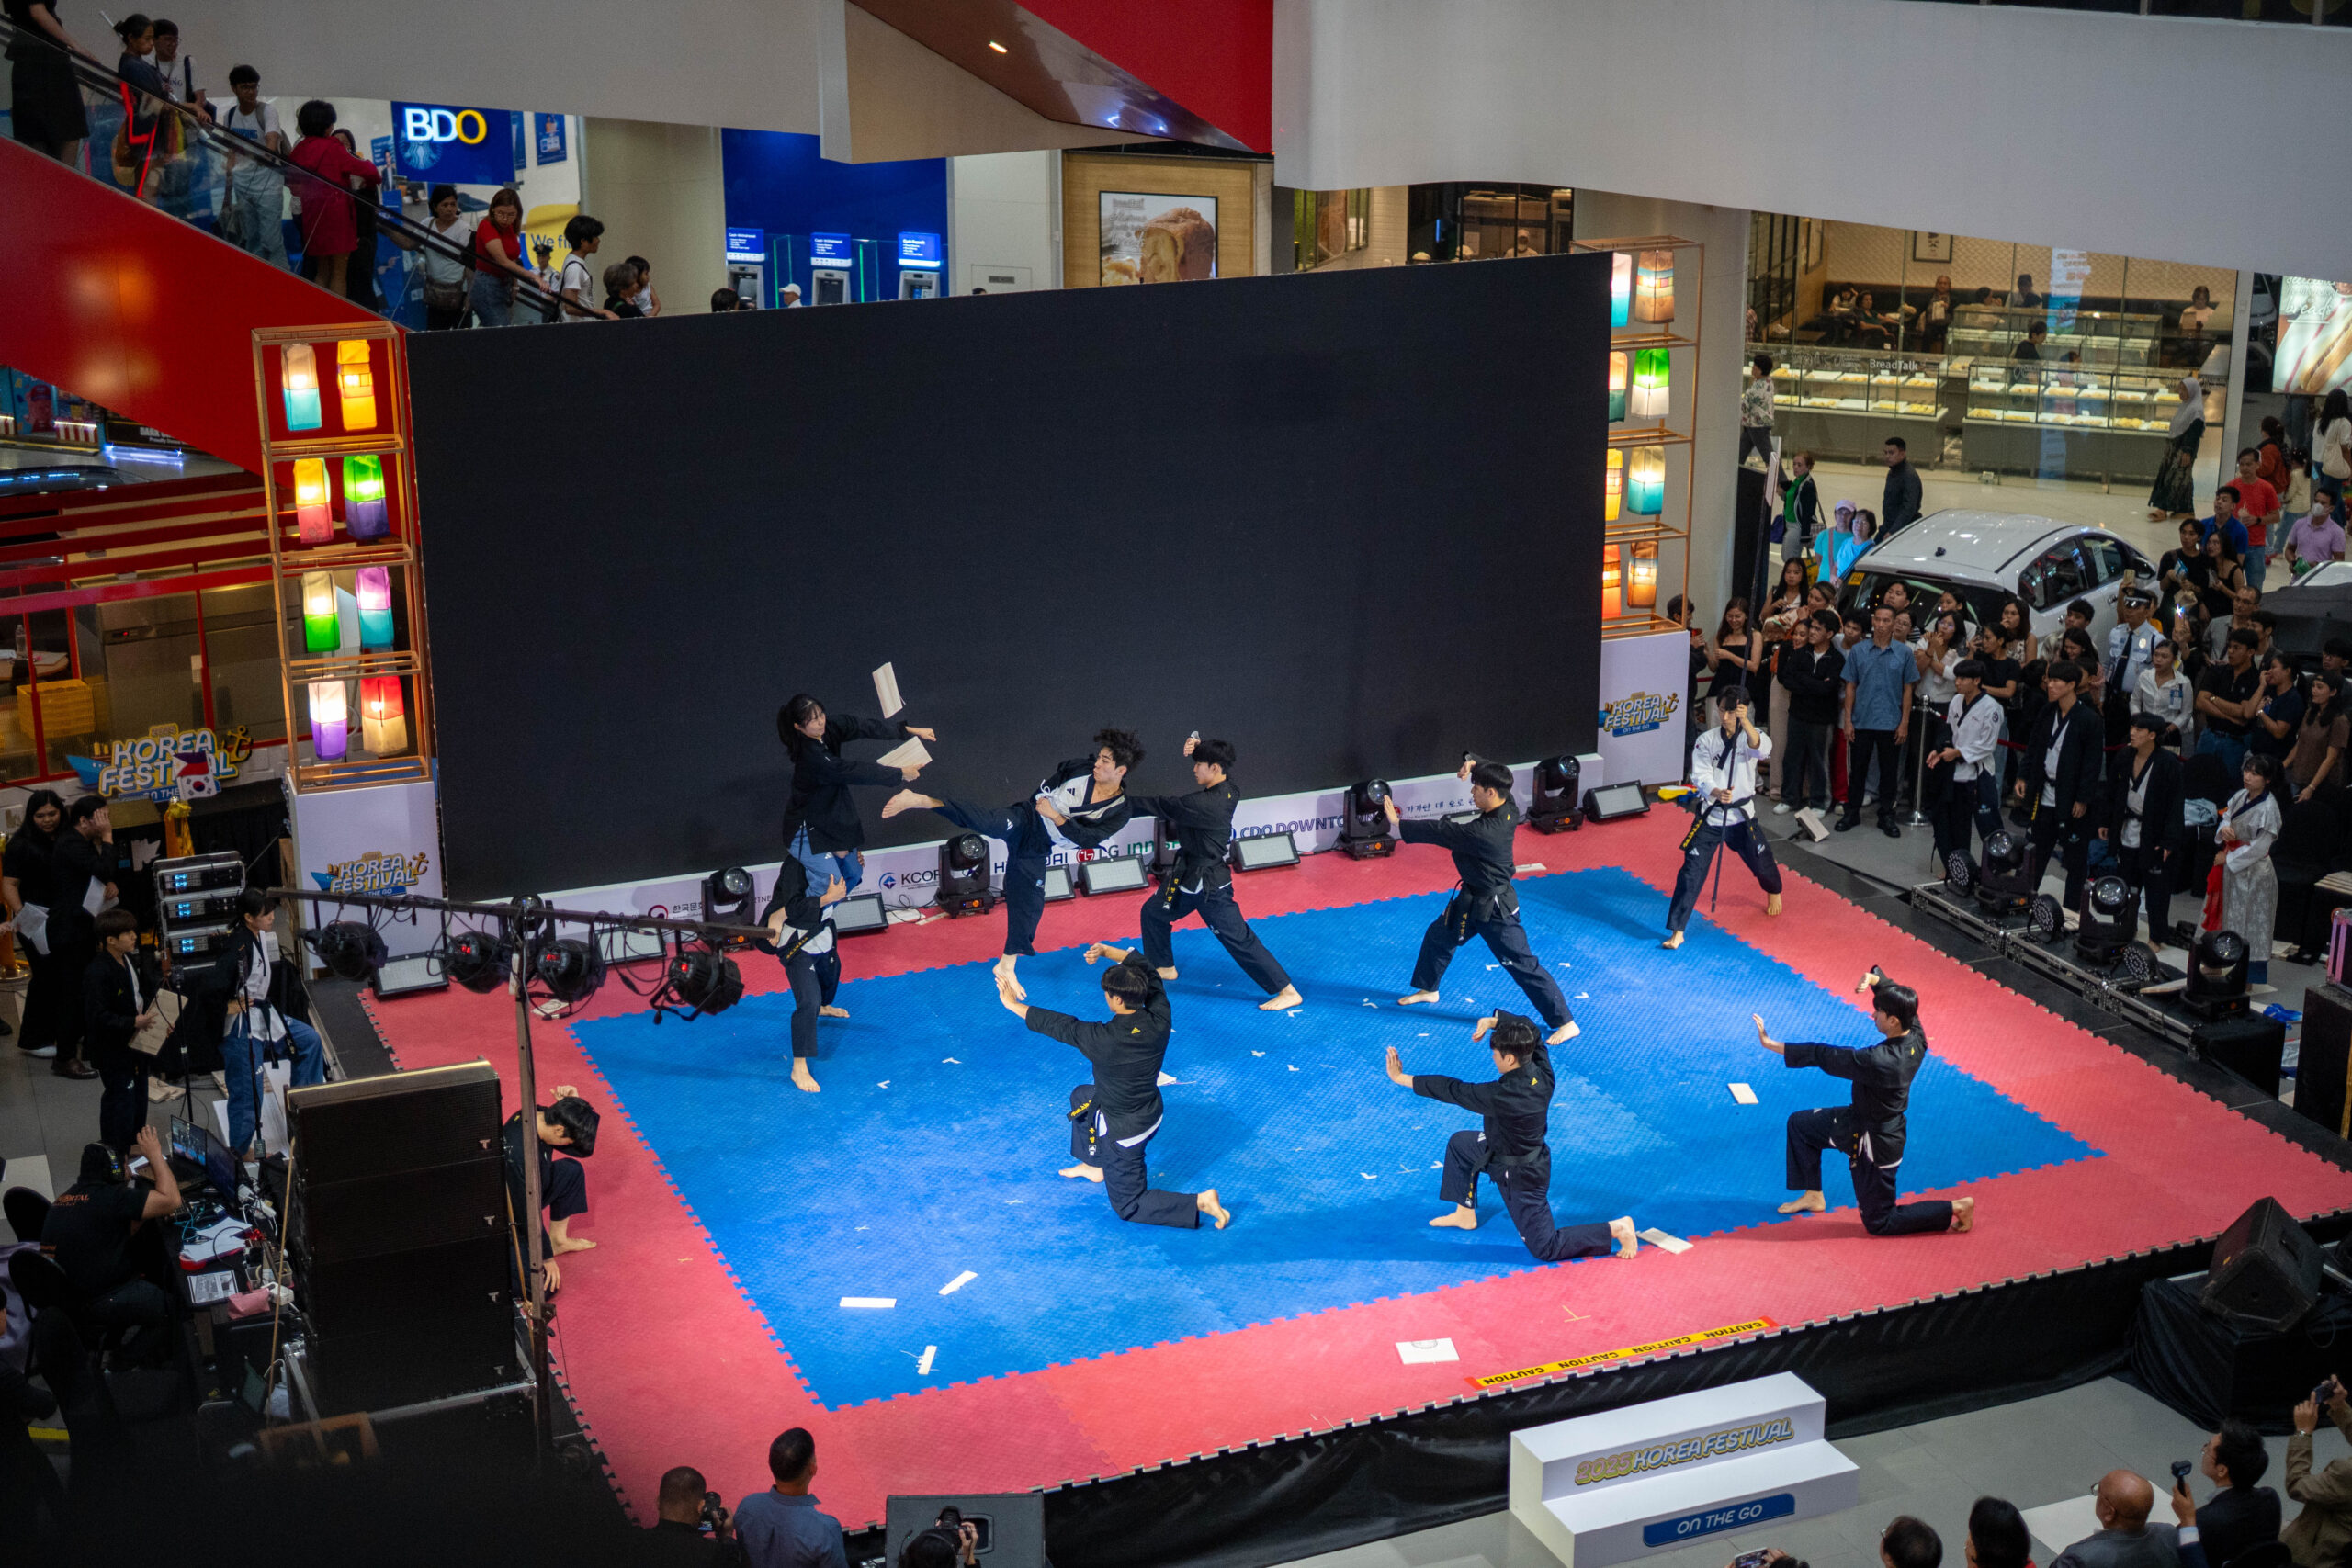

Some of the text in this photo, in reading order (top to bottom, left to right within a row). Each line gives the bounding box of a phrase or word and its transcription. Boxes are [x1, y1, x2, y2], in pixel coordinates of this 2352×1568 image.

[405, 107, 487, 144] BDO
[531, 233, 555, 249] We
[1870, 358, 1918, 371] BreadTalk
[1613, 695, 1661, 715] KOREA
[1605, 708, 1668, 729] FESTIVAL
[113, 730, 213, 765] KOREA
[101, 751, 235, 794] FESTAL
[1240, 824, 1273, 838] CDO
[341, 856, 403, 878] KOREA
[332, 869, 417, 893] FESTIVAL
[1483, 1322, 1762, 1385] CAUTION CAUTION CAUTION CAUTION
[1577, 1420, 1792, 1482] 2025 KOREA FESTIVAL
[1677, 1504, 1762, 1535] ON THE GO
